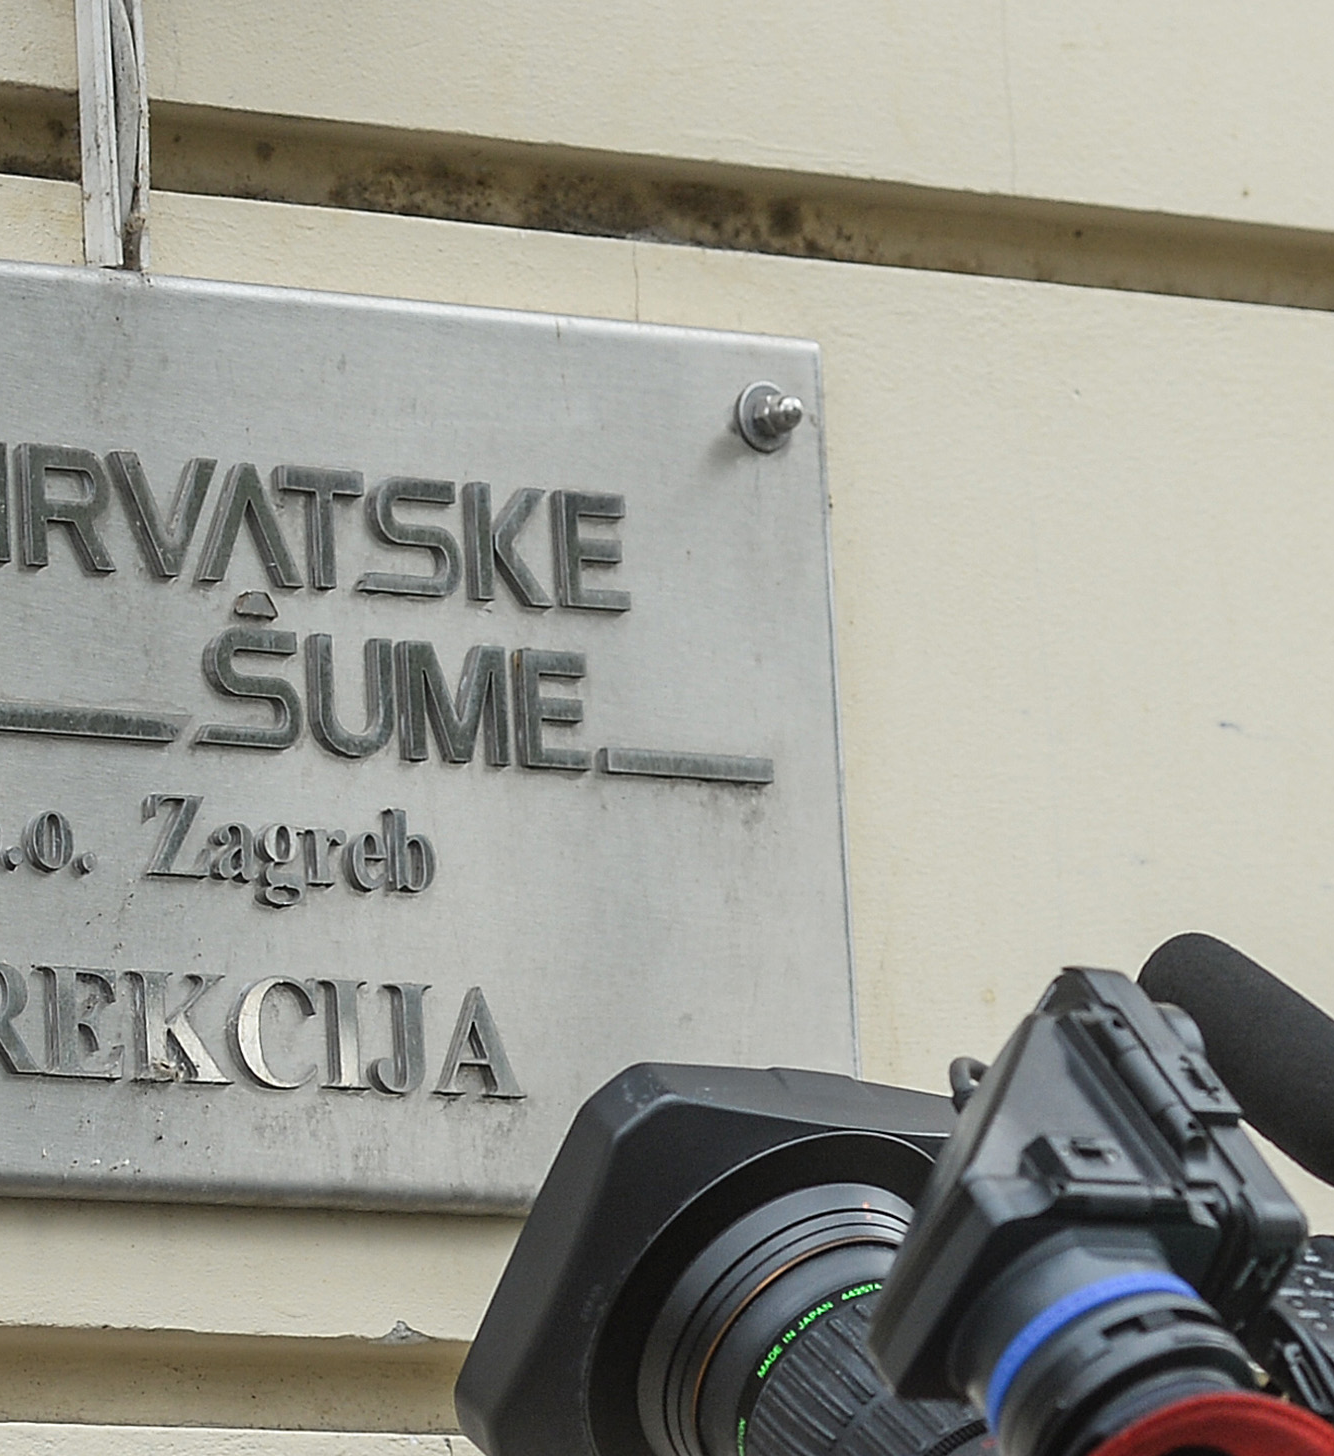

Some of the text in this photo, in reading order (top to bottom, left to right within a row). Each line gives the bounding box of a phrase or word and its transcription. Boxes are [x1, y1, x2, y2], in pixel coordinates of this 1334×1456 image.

[193, 590, 592, 771] ŠUME
[140, 793, 438, 909] Zagreb
[757, 1344, 783, 1378] MADE
[782, 1329, 797, 1344] IN
[798, 1301, 834, 1330] JAPAN
